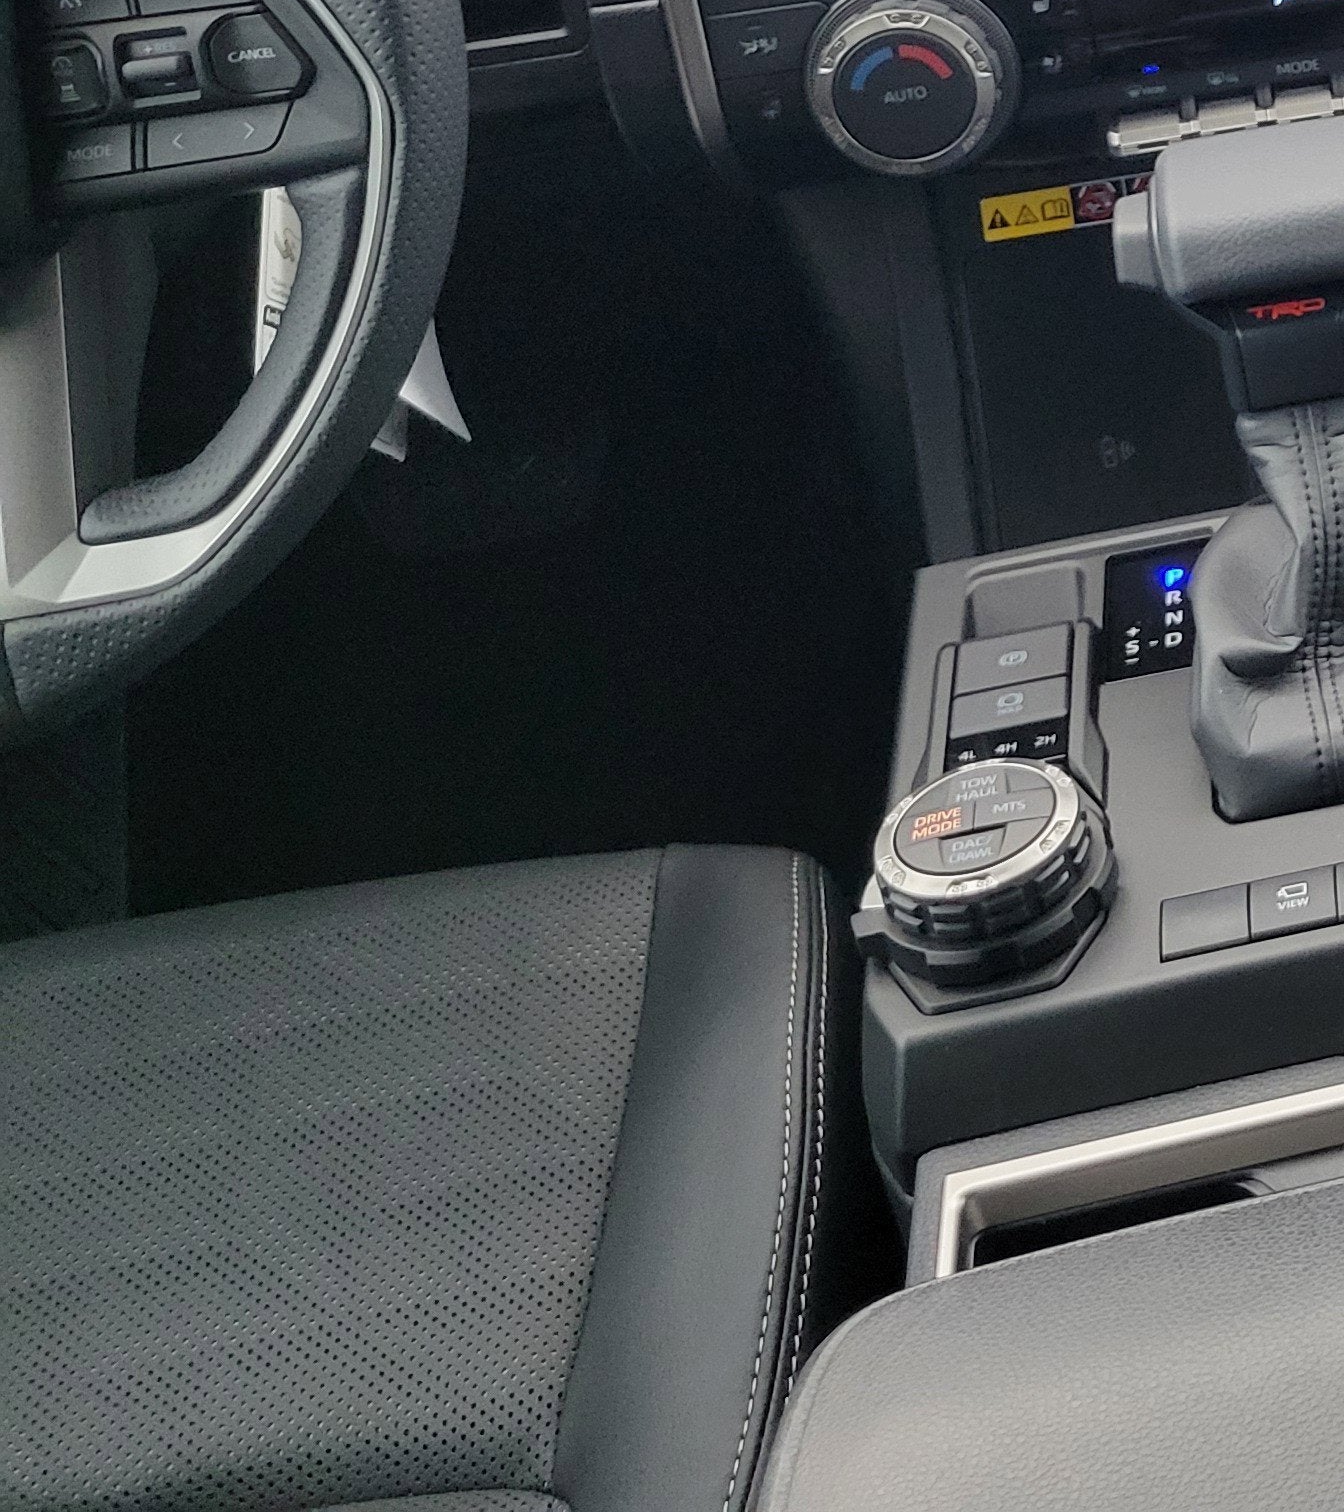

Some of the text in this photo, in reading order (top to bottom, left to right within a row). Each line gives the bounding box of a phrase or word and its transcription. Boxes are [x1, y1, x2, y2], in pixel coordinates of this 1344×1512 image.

[227, 46, 277, 64] CANCEL
[1276, 58, 1320, 76] MODE
[883, 85, 928, 105] AUTO
[66, 143, 115, 162] MODE
[1246, 297, 1327, 320] TRD
[1164, 568, 1184, 588] P
[1164, 590, 1183, 607] R
[1164, 609, 1184, 627] N
[1164, 631, 1183, 648] D
[957, 733, 1057, 763] 4L 4H 2H
[960, 773, 999, 790] TOW
[955, 785, 999, 803] HAUL
[991, 800, 1027, 815] MTS
[914, 805, 963, 829] DRIVE
[910, 818, 963, 842] MODE
[948, 845, 995, 865] CRAWL
[1275, 895, 1311, 912] VIEW
